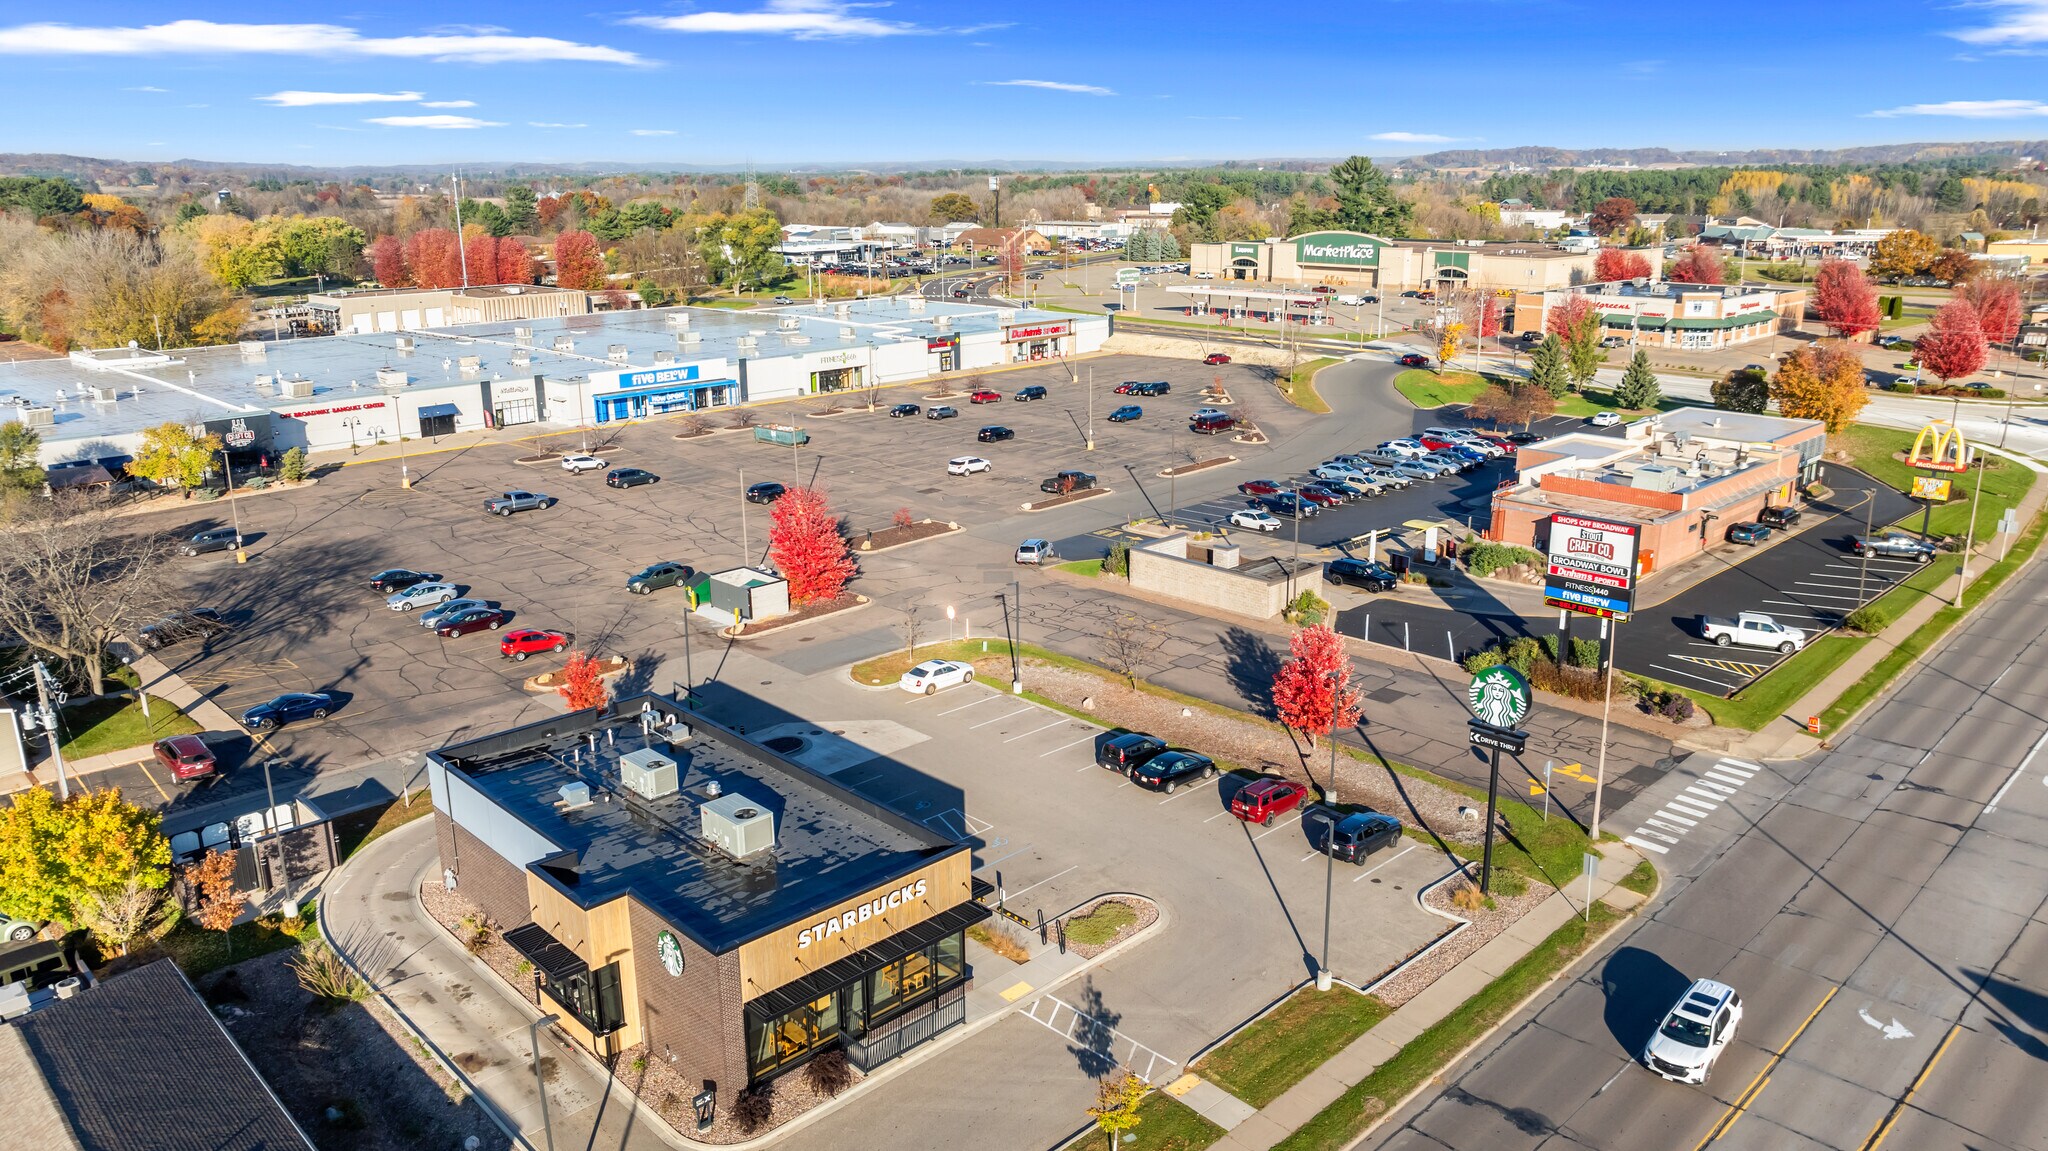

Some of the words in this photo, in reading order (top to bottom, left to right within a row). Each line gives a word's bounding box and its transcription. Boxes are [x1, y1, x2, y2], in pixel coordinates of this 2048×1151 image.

[1304, 244, 1373, 258] MarketPlace
[1011, 327, 1042, 339] Dunham's
[1043, 325, 1067, 335] SPORTS
[632, 373, 655, 385] five
[656, 369, 688, 383] BELOW
[293, 408, 330, 418] BROADWAY
[332, 405, 362, 413] BANQUET
[363, 402, 385, 410] CENTER
[1915, 461, 1955, 471] McDonald's
[1557, 516, 1578, 526] SHOPS
[1579, 519, 1592, 527] OFF
[1592, 521, 1629, 534] BROADWAY
[1581, 530, 1602, 541] STOUT
[1569, 538, 1597, 555] CRAFT
[1597, 542, 1612, 558] CO.
[1553, 556, 1599, 571] BROADWAY
[1600, 566, 1625, 576] BOWL
[1594, 576, 1620, 586] SPORTS
[1559, 601, 1578, 610] SELF
[1562, 590, 1581, 601] five
[1582, 595, 1610, 607] BELOW
[1480, 736, 1499, 747] DRIVE
[1499, 741, 1516, 752] THRU
[797, 879, 927, 949] STARBUCKS
